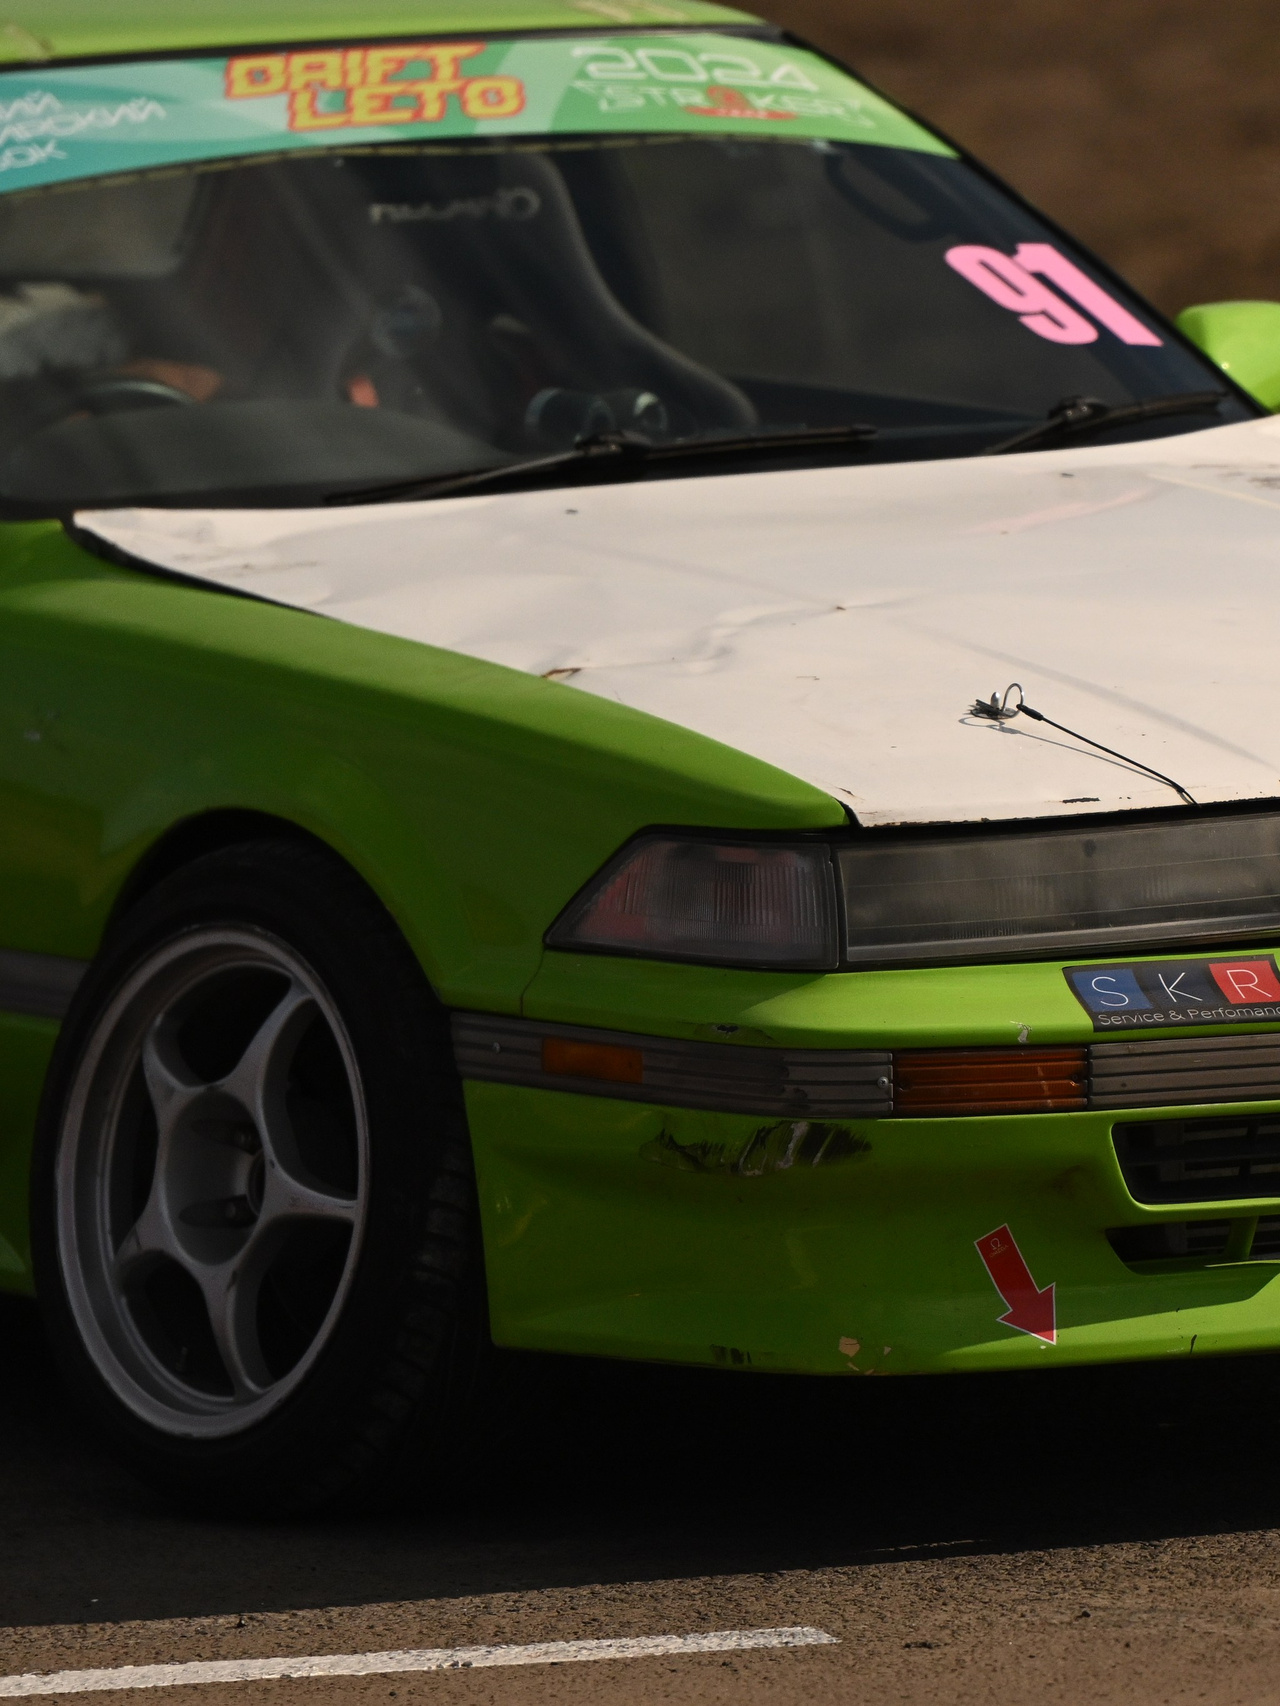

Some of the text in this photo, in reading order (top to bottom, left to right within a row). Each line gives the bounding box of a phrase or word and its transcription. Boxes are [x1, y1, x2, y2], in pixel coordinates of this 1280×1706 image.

[571, 46, 819, 92] 2024
[287, 75, 526, 132] LETO
[944, 242, 1164, 347] 91
[1091, 968, 1273, 1007] SKR
[1097, 1010, 1165, 1026] Service
[1168, 1010, 1186, 1021] &
